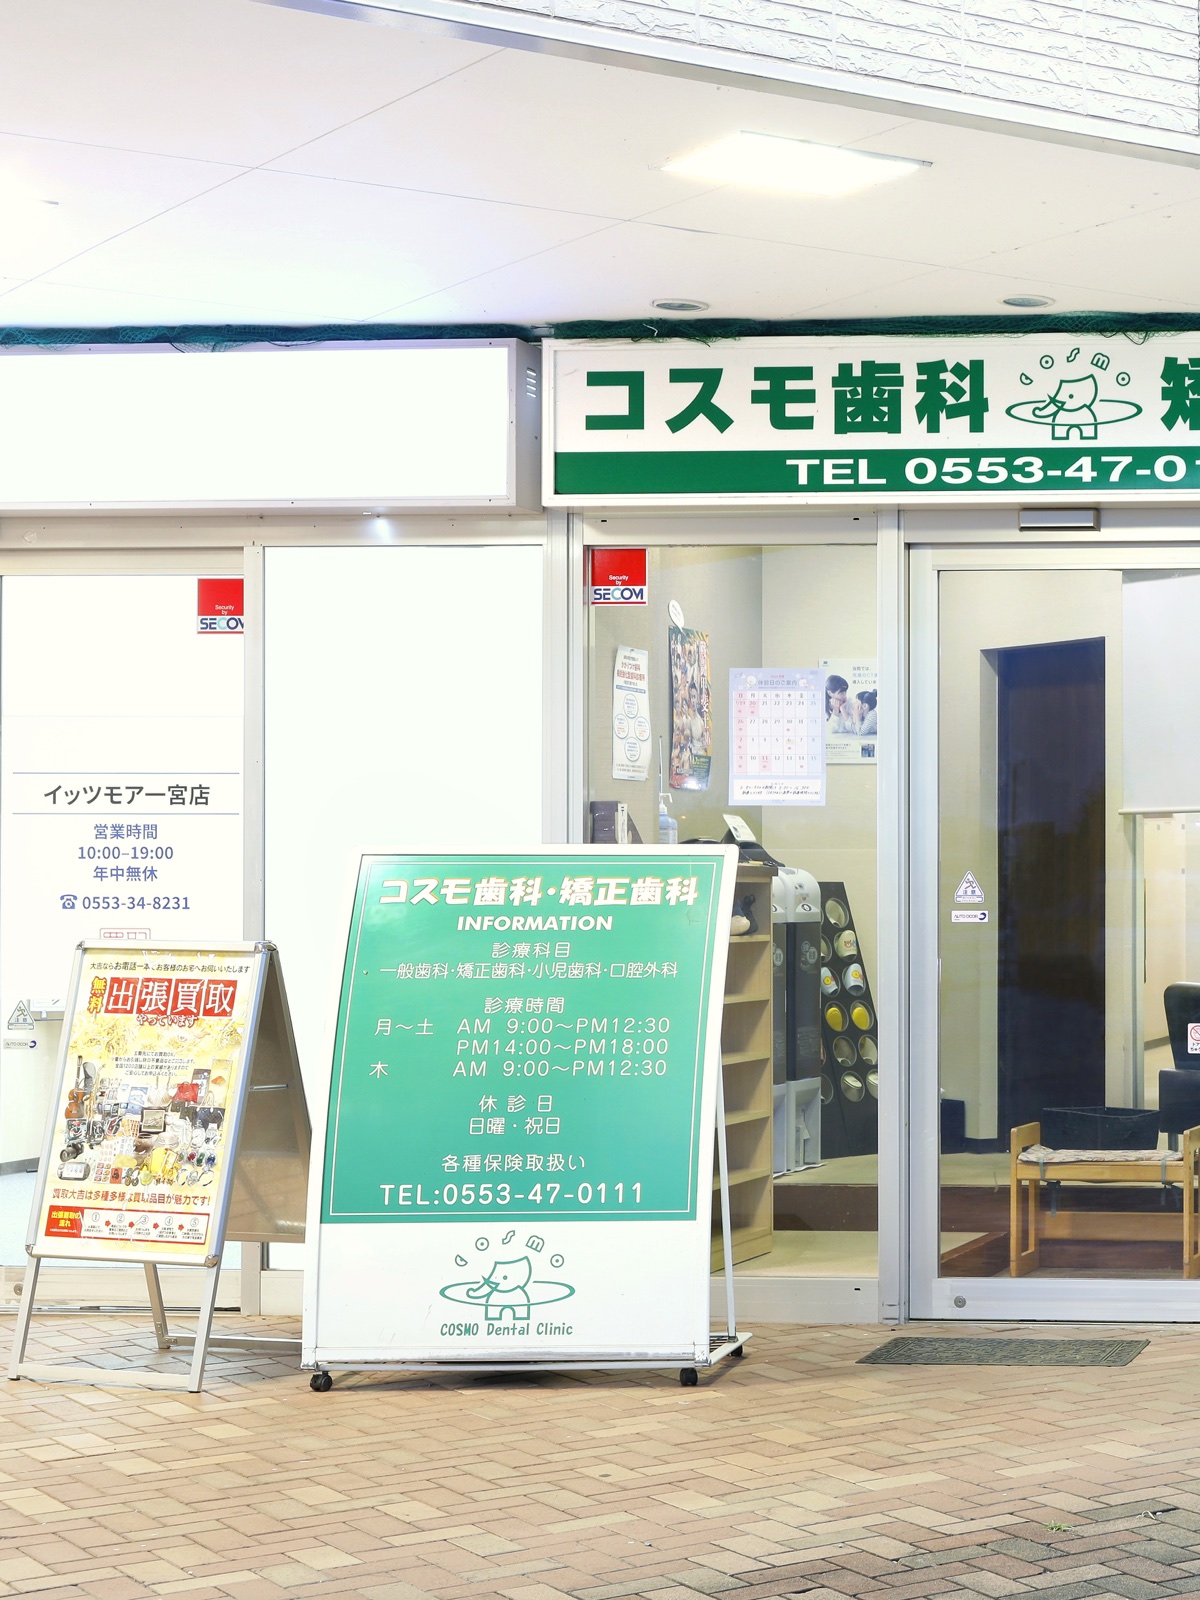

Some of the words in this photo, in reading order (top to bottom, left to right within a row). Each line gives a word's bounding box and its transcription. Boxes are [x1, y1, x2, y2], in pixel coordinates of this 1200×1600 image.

[585, 359, 989, 434] コスモ歯科
[785, 458, 886, 485] TEL
[593, 587, 644, 601] SECOM
[93, 823, 158, 840] 営業時間
[93, 865, 158, 882] 年中無休
[379, 875, 699, 907] コスモ歯科・矯正歯科
[81, 896, 191, 911] 0553-34-8231
[457, 916, 613, 931] INFORMATION
[491, 942, 571, 958] 診療科目
[88, 975, 108, 1013] 無料
[108, 980, 235, 1013] 出張買取
[484, 997, 565, 1014] 診療時間
[136, 1014, 199, 1027] やっています
[456, 1019, 491, 1034] AM
[369, 1060, 389, 1078] 木
[453, 1062, 487, 1077] AM
[441, 1153, 585, 1172] 各種保険取扱い
[379, 1182, 643, 1206] TEL:0553-47-0111
[440, 1322, 479, 1337] COSMO
[487, 1322, 530, 1336] Dental
[536, 1322, 573, 1336] Clinic
